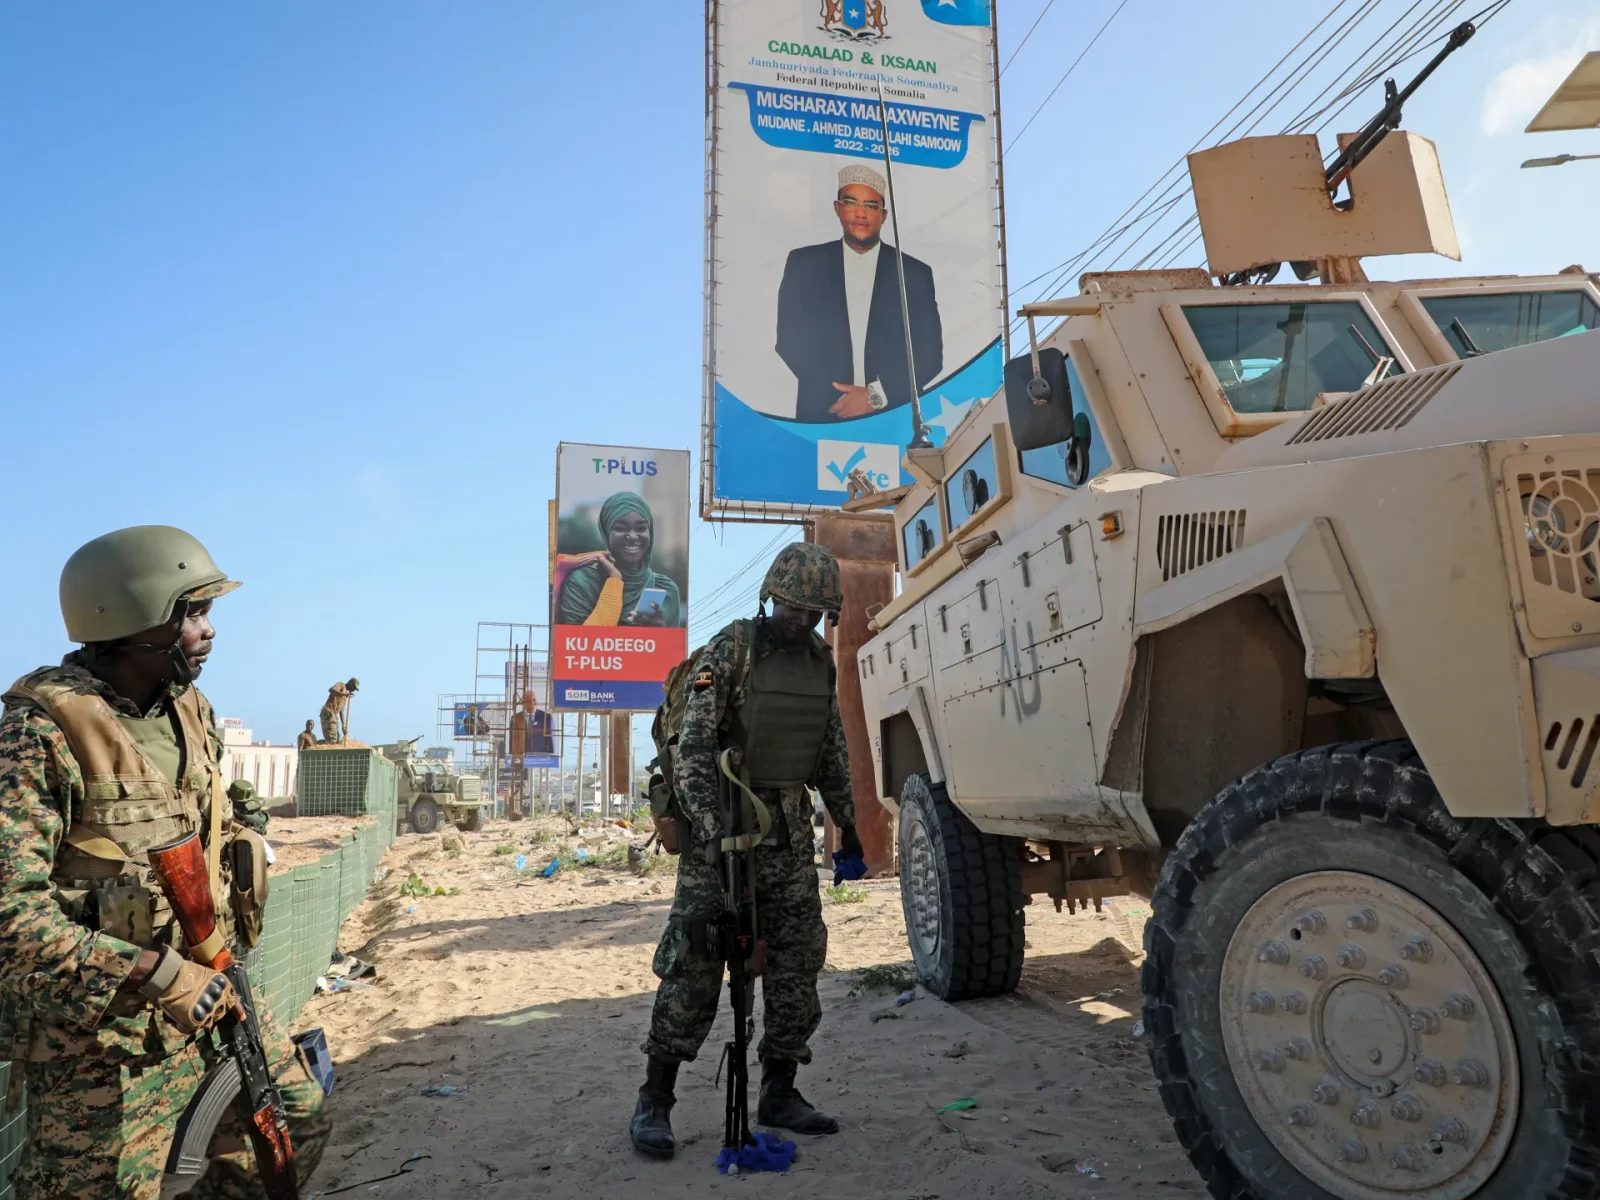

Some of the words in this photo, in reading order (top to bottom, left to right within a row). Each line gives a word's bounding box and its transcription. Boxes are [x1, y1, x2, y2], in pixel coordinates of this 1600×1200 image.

[748, 56, 829, 75] Jamhuuriyada
[768, 39, 854, 62] CADAALAD
[860, 51, 874, 65] &
[881, 54, 937, 74] IXSAAN
[776, 72, 817, 86] Federal
[820, 78, 868, 92] Republic
[884, 86, 926, 100] Somalia
[756, 90, 848, 118] MUSHARAX
[757, 113, 806, 132] MUDANE
[812, 120, 853, 137] AHMED
[853, 126, 912, 146] ABDULAHI
[913, 134, 962, 153] SAMOOW
[834, 138, 864, 152] 2022
[565, 636, 589, 652] KU
[592, 637, 657, 653] ADEEGO
[564, 655, 623, 671] T-PLUS
[1000, 621, 1042, 724] AU
